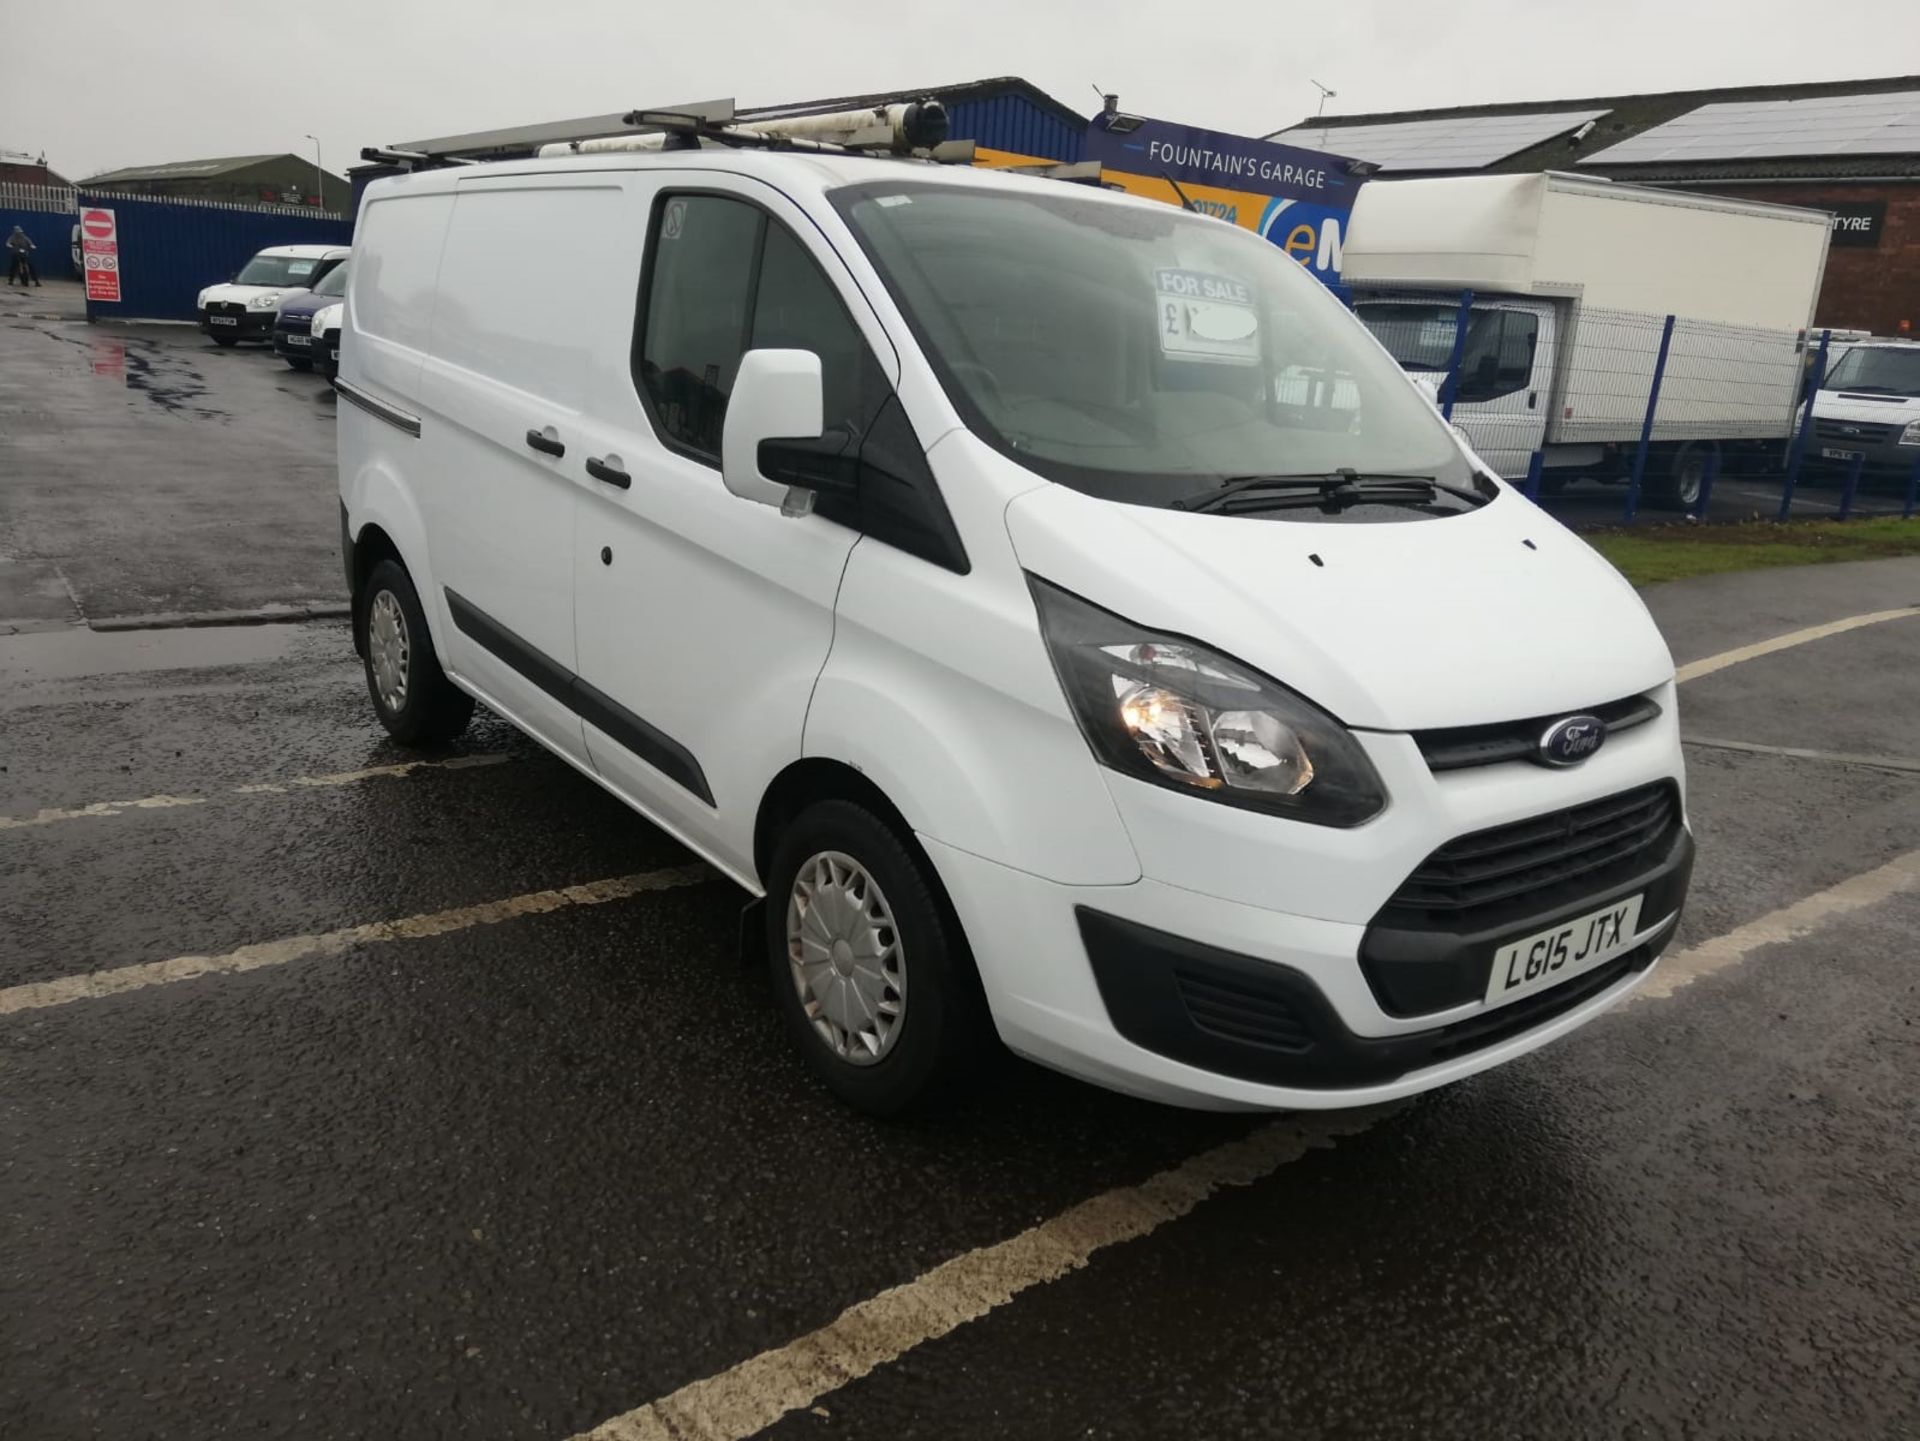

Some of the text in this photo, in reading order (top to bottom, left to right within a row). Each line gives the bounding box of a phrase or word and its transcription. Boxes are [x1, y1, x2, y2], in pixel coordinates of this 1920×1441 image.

[1150, 141, 1326, 189] FOUNTAIN'S GARAGE
[1833, 217, 1872, 230] TYRE
[1161, 273, 1249, 302] FOR SALE
[1562, 724, 1599, 756] Ford
[1504, 907, 1628, 990] LG15 JTX
